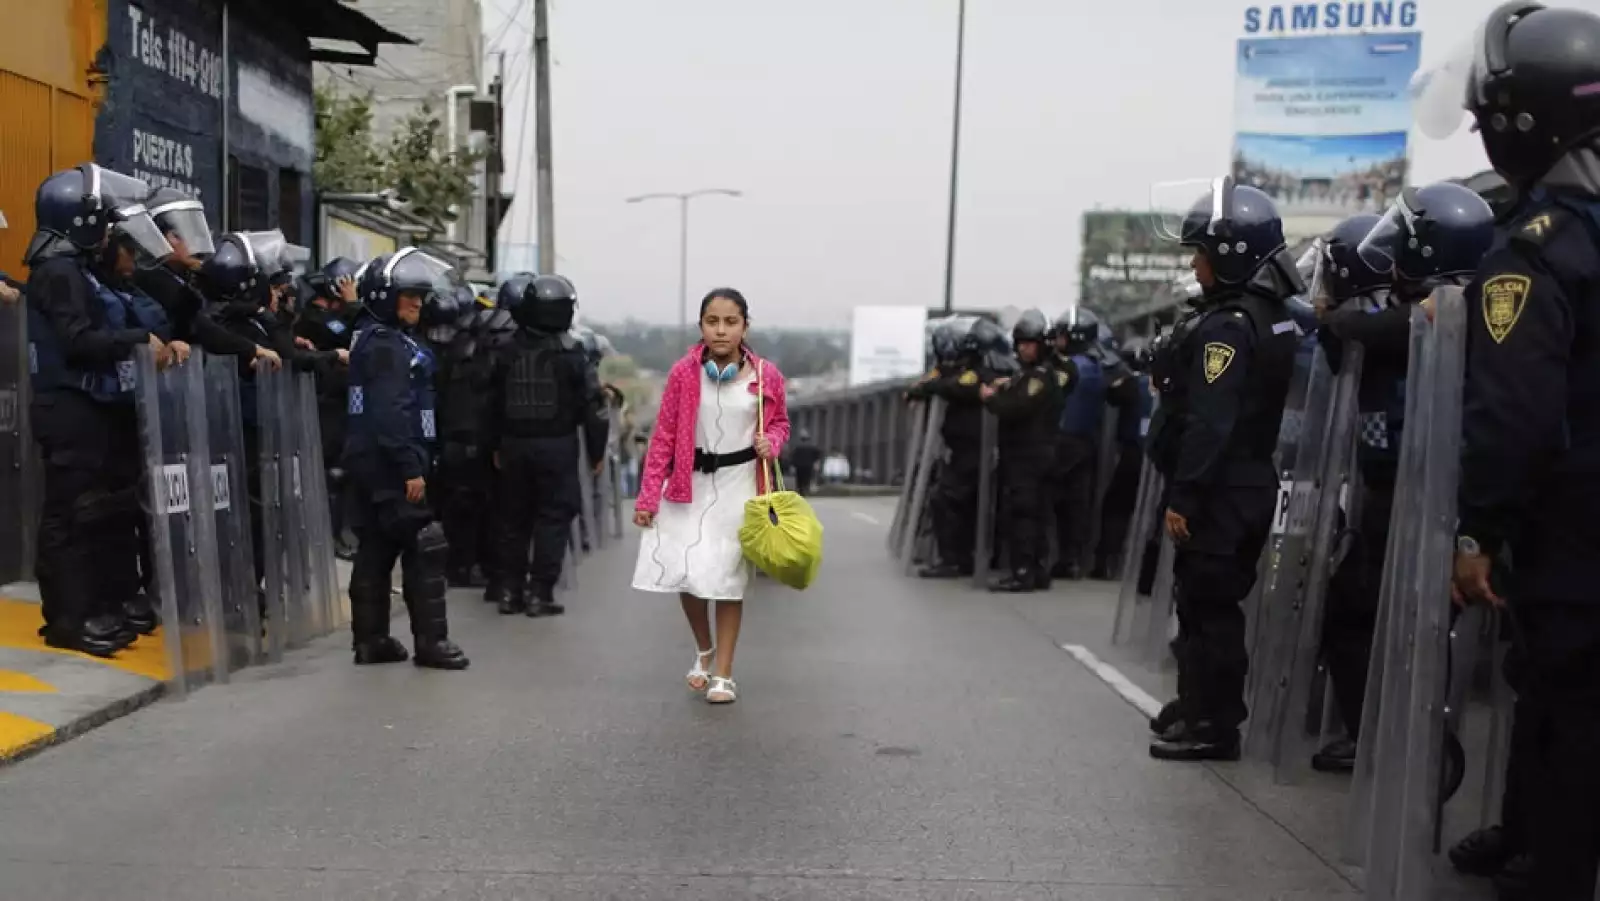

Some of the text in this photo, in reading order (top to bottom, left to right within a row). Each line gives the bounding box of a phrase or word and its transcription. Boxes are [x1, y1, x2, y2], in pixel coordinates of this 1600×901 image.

[128, 3, 166, 72] Tels.
[1244, 1, 1417, 32] SAMSUNG
[133, 128, 193, 179] PUERTAS
